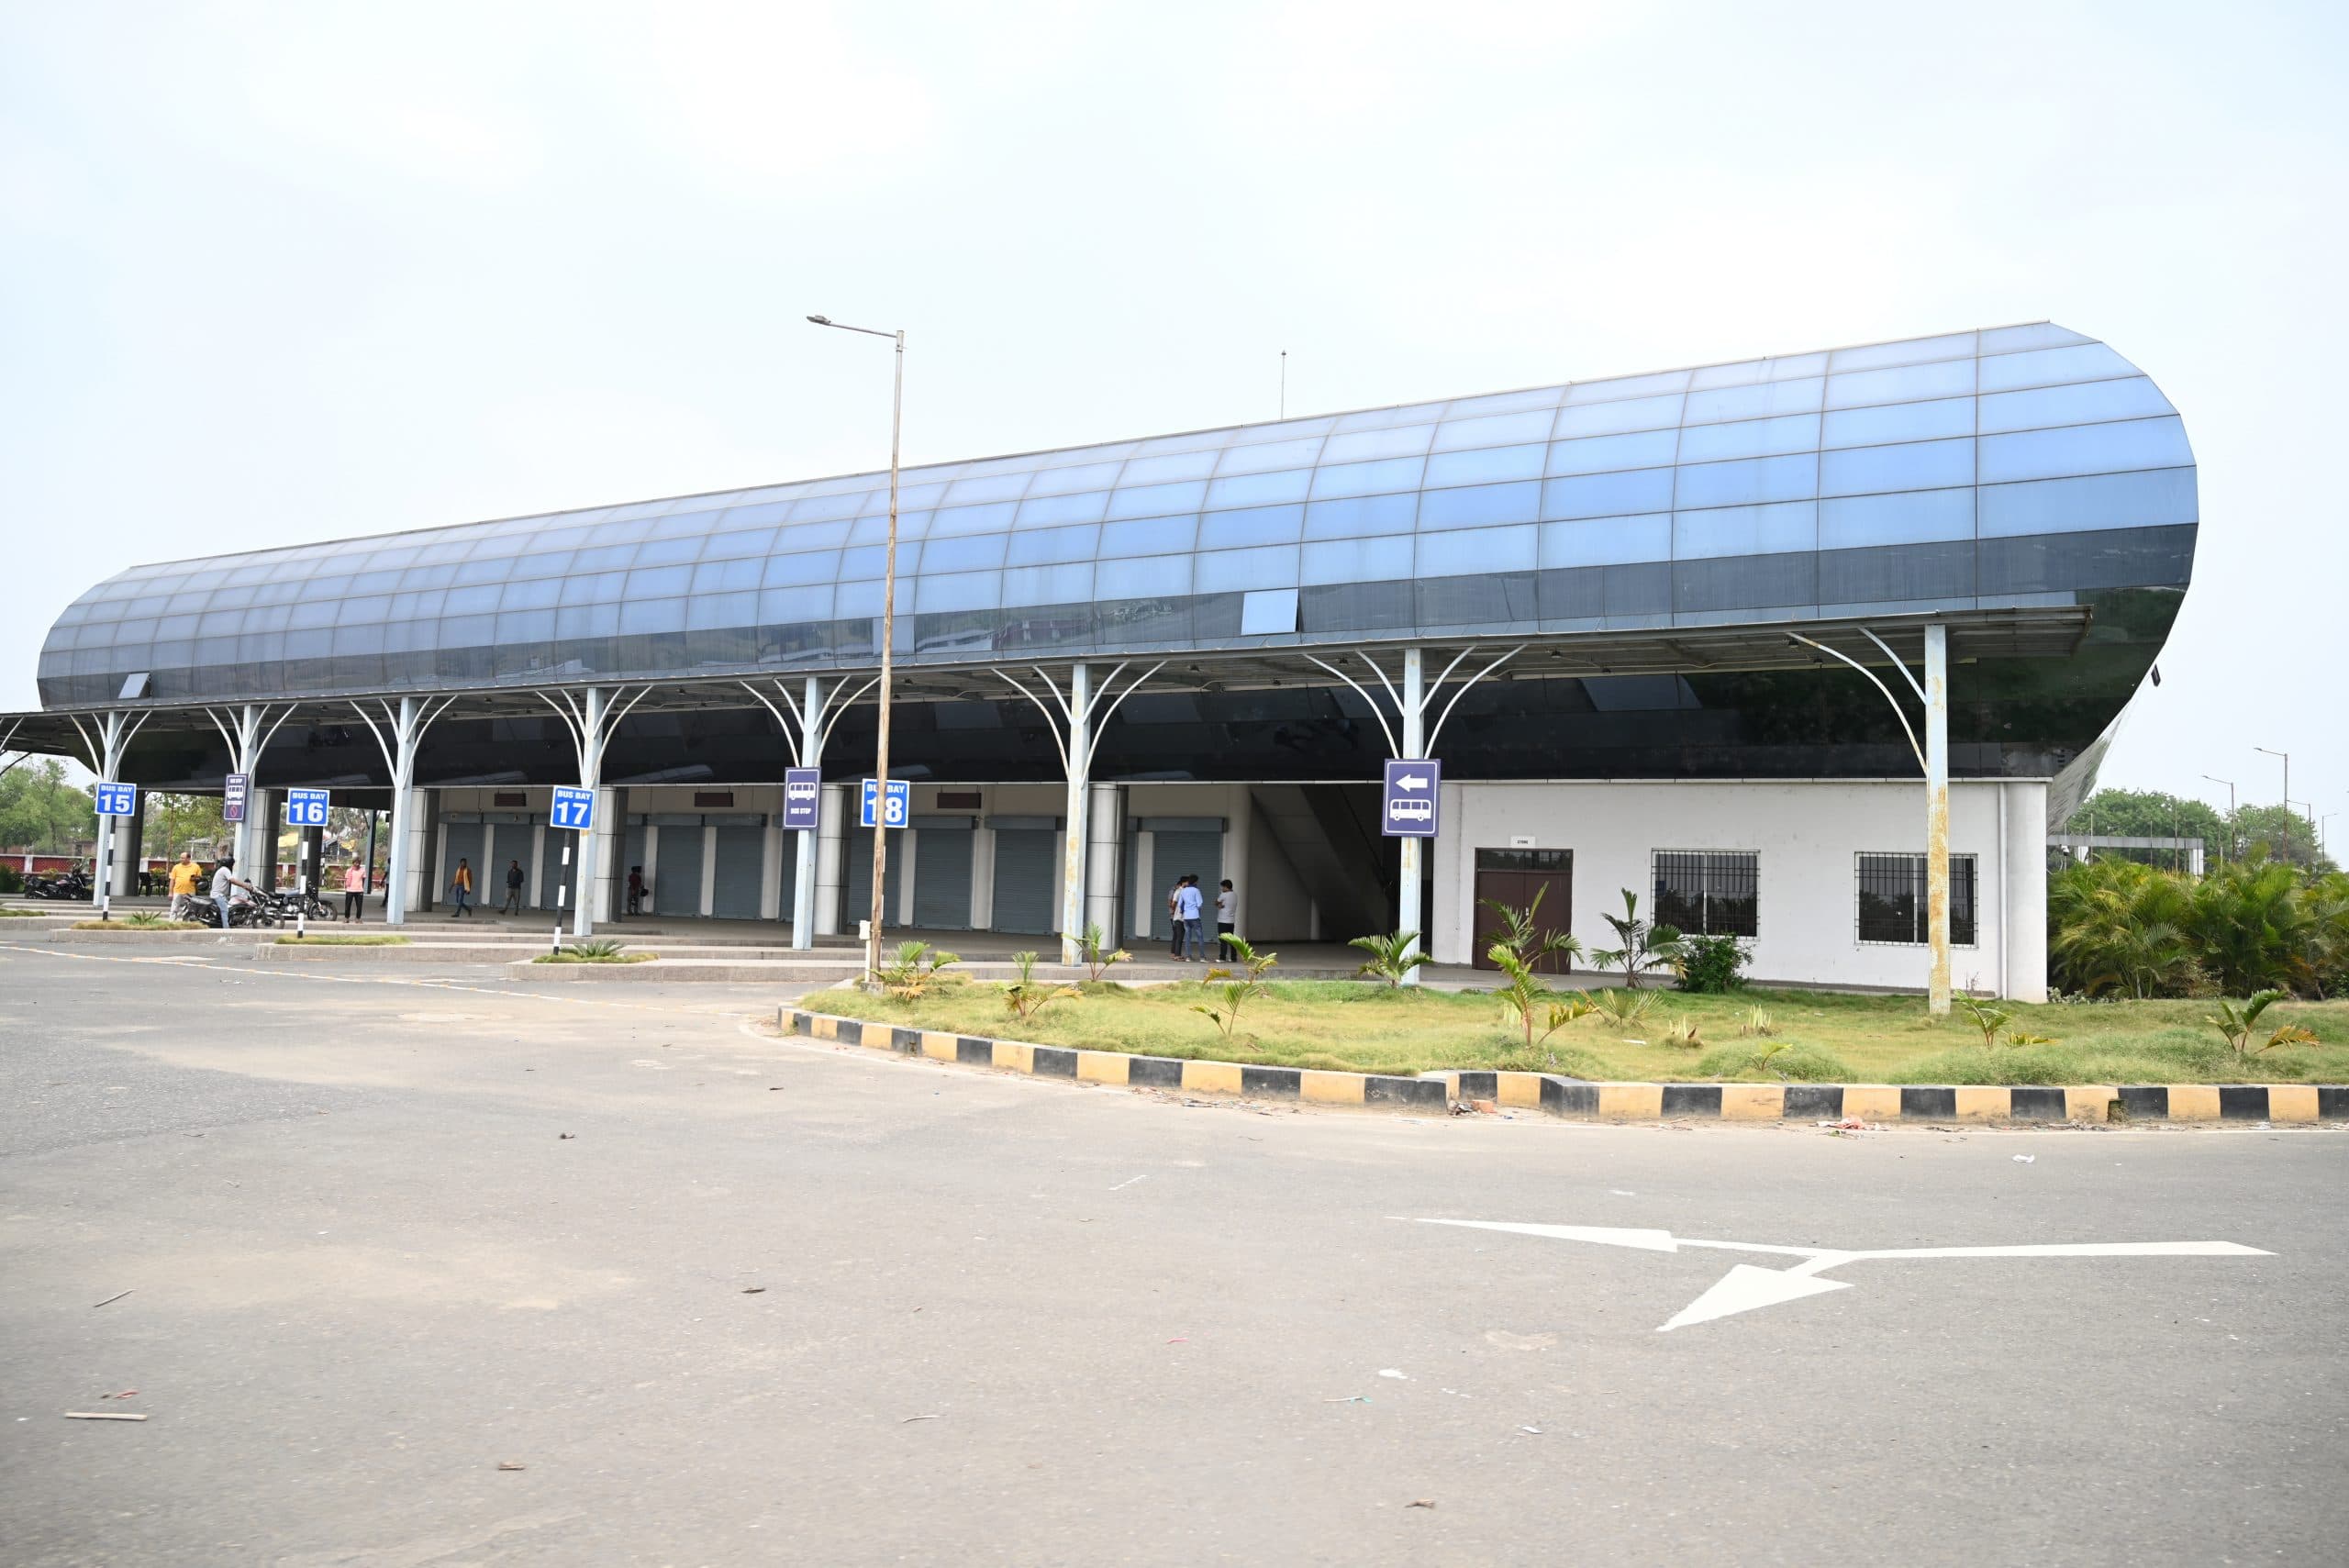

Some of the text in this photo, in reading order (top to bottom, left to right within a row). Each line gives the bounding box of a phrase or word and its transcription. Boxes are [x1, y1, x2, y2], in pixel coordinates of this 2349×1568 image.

[557, 790, 591, 800] BUS BAY
[867, 784, 905, 794] BU BAY
[100, 794, 130, 813] 15
[293, 802, 323, 823] 16
[556, 801, 588, 825] 17
[867, 796, 902, 823] 18
